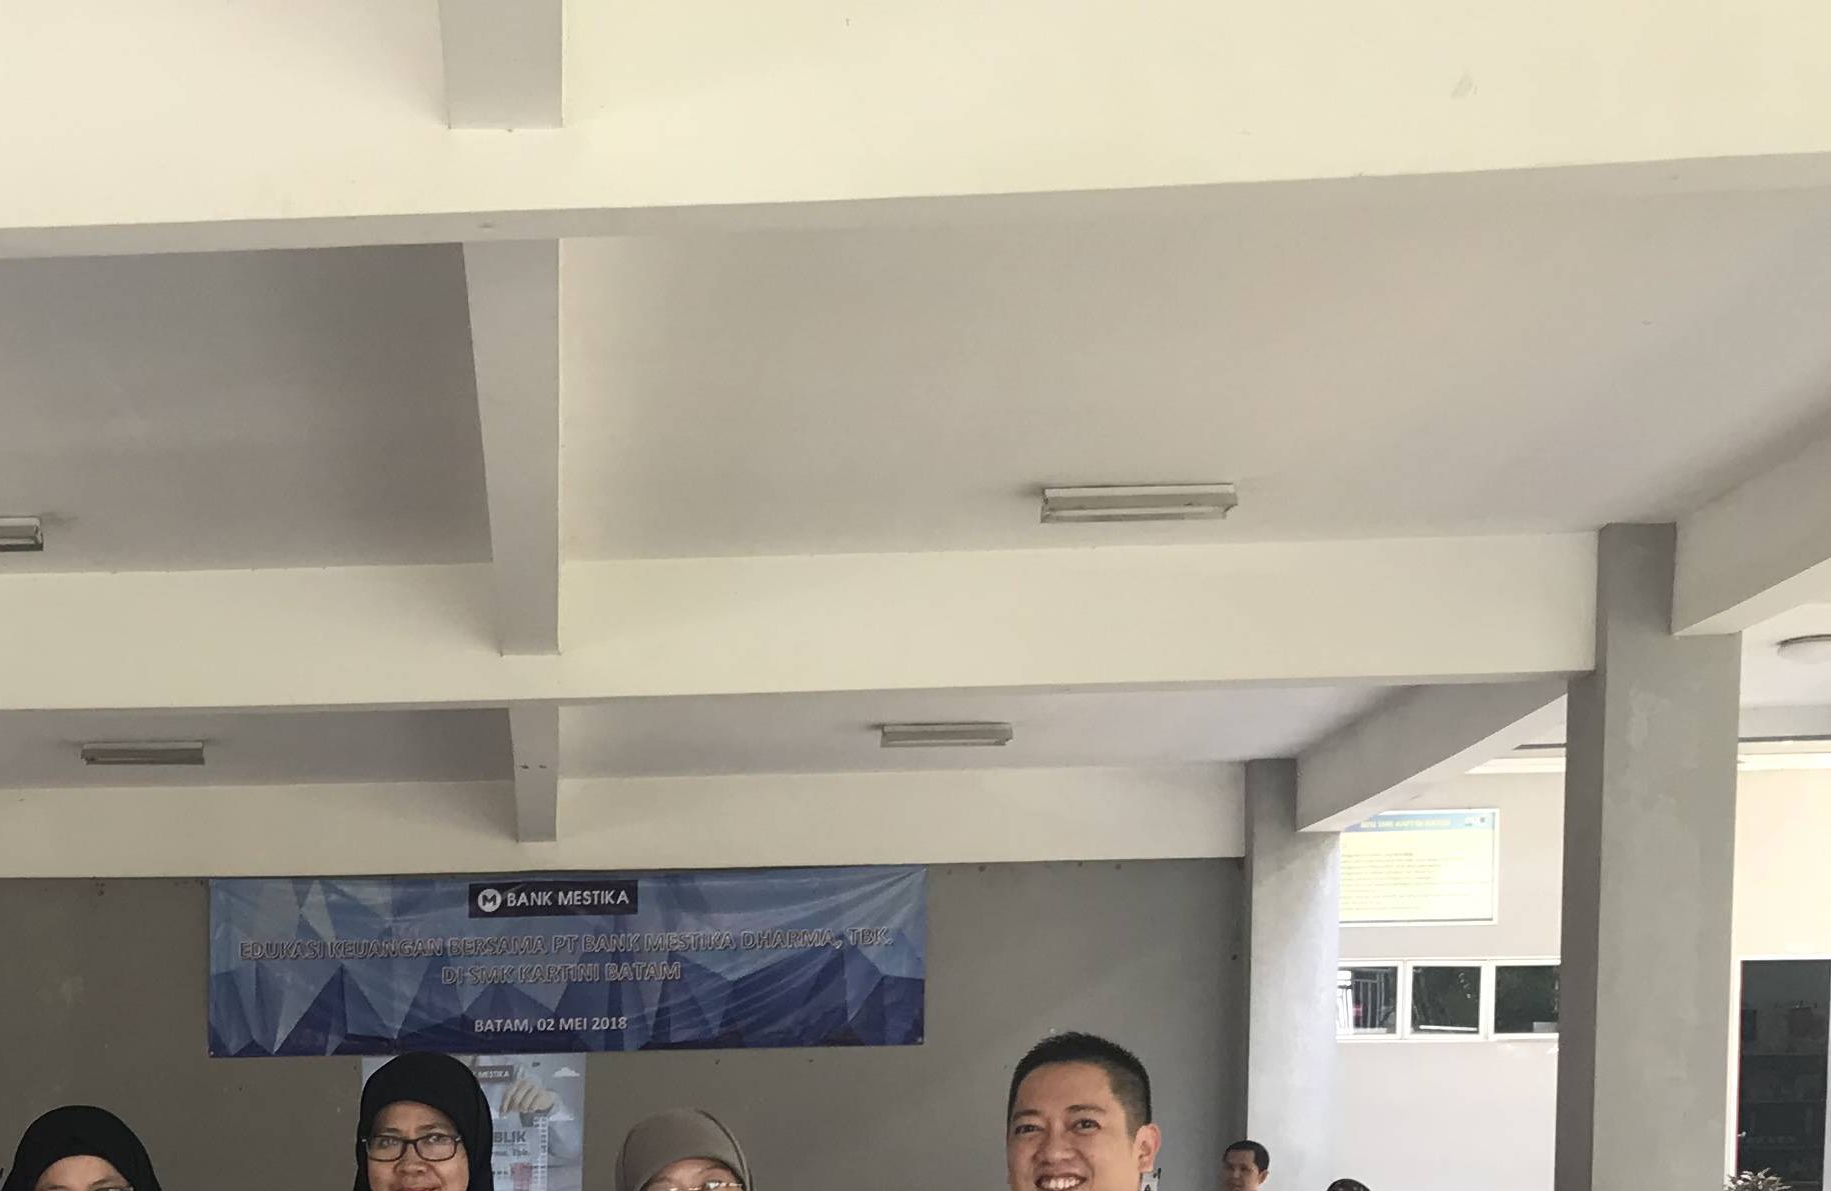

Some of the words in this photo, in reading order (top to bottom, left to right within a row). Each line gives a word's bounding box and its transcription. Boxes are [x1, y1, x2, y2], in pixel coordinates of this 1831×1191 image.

[507, 892, 552, 907] BANK
[559, 889, 630, 906] MESTIKA
[240, 939, 326, 961] EDUKASI
[329, 936, 444, 960] KEUANGAN
[448, 935, 547, 958] BERSAMA
[553, 933, 578, 952] PT
[583, 932, 640, 953] BANK
[644, 929, 737, 952] MESTIKA
[442, 965, 465, 985] DI
[470, 965, 516, 985] SMK
[520, 961, 600, 984] KARTINI
[604, 960, 682, 982] BATAM
[474, 1018, 534, 1034] BATAM,
[536, 1018, 555, 1032] 02
[558, 1017, 587, 1032] MEI
[592, 1016, 627, 1031] 2018
